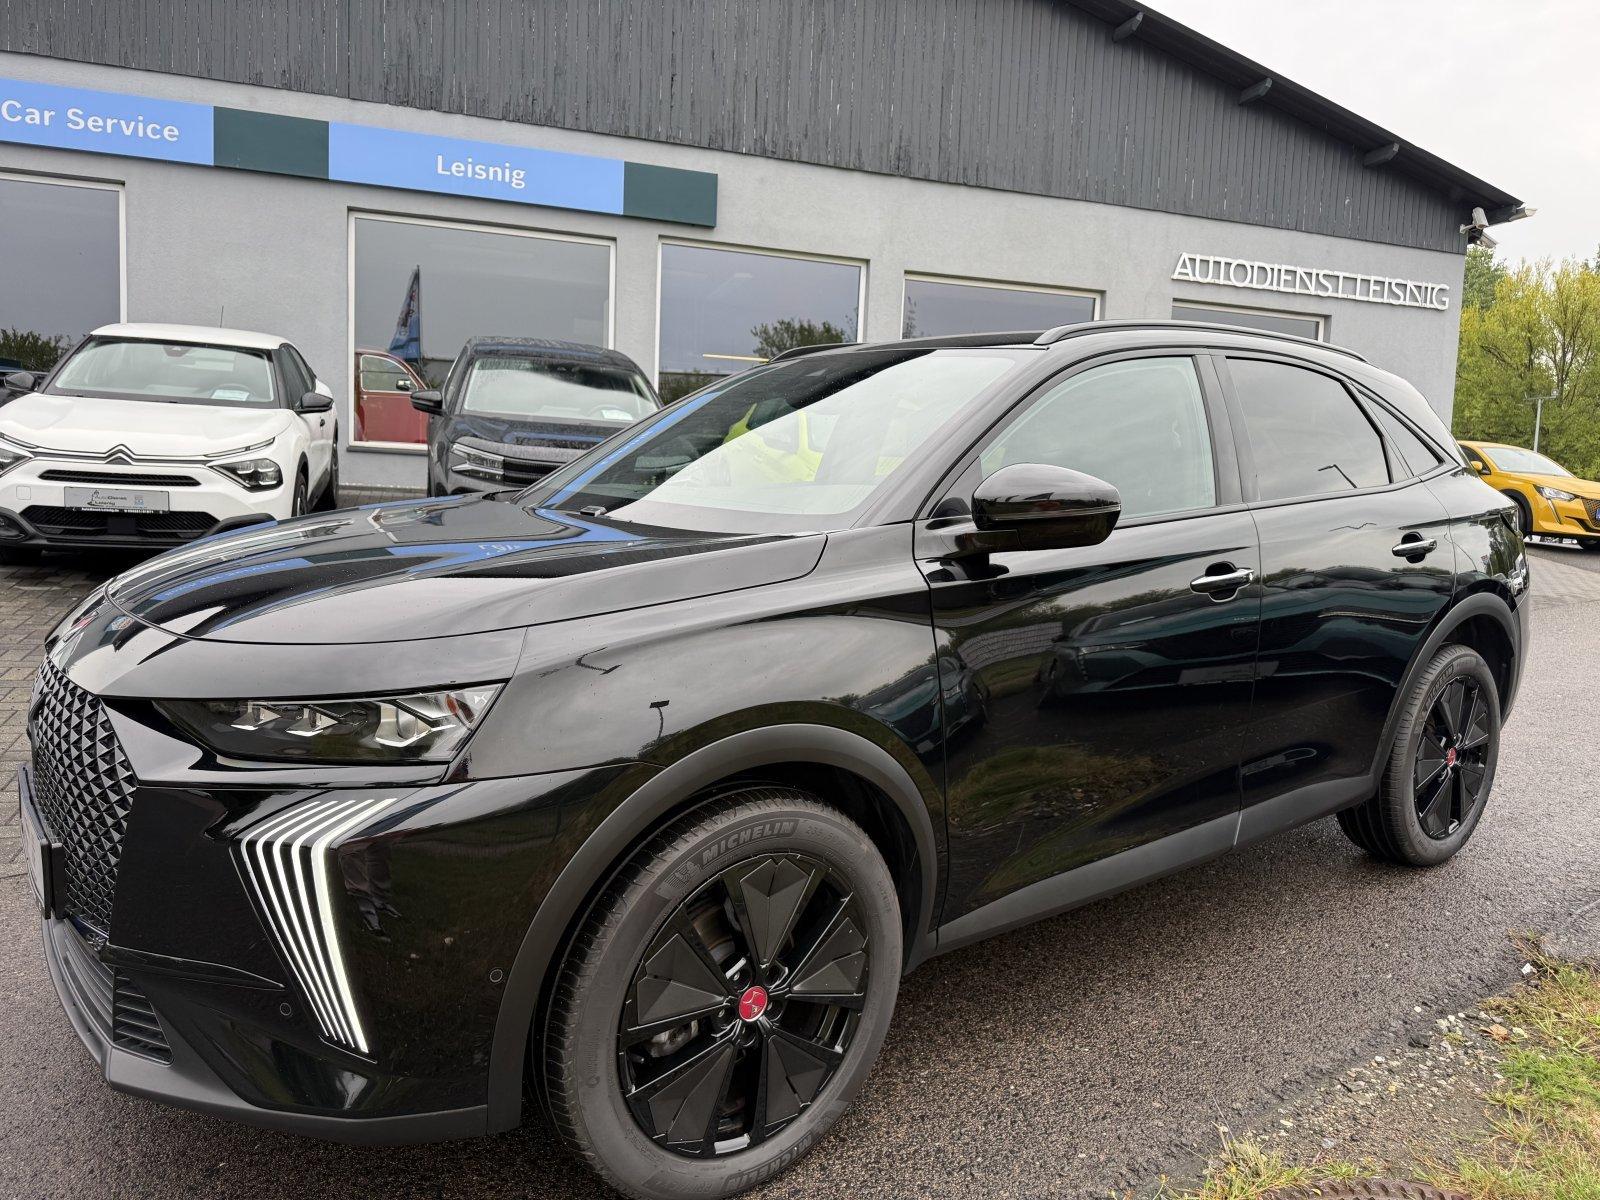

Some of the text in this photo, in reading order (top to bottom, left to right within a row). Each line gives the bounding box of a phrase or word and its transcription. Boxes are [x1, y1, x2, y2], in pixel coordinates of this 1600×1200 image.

[1, 100, 179, 141] Car Service
[437, 155, 526, 189] Leisnig
[1172, 252, 1449, 310] AUTODIENST LEISNIG
[702, 821, 795, 864] MICHELIN
